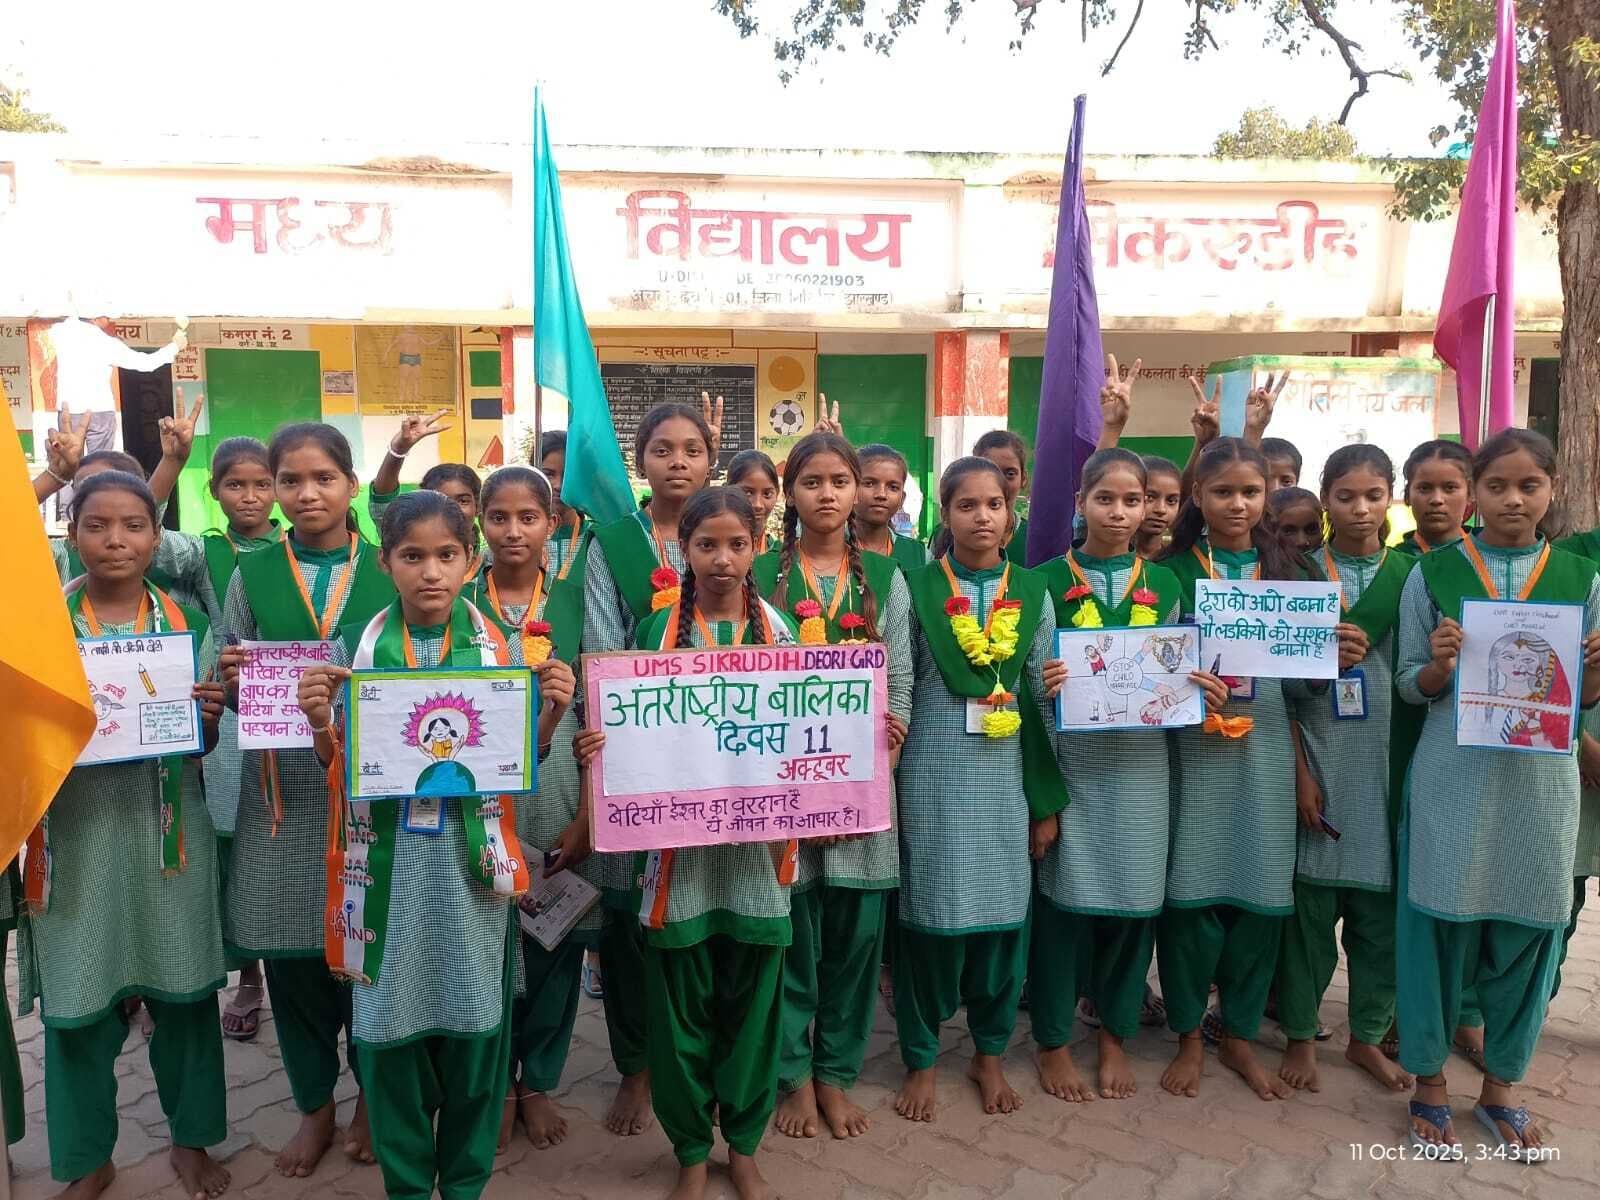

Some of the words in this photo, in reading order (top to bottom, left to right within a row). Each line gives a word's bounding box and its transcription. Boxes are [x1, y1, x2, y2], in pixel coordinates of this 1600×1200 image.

[195, 195, 399, 256] मध्य
[615, 189, 911, 269] विद्यालय
[1043, 197, 1357, 279] िकरुडीह
[282, 328, 293, 341] 2
[1228, 586, 1250, 612] को
[634, 656, 682, 677] UMS
[804, 650, 846, 671] DEORI
[768, 674, 873, 718] बालिका
[714, 719, 790, 757] दिवस
[803, 724, 832, 755] 11
[776, 754, 852, 782] अक्टूबर
[607, 799, 668, 828] बेटियाँ
[709, 799, 728, 816] का
[731, 793, 787, 816] वरदान
[725, 814, 769, 832] जीवन
[773, 815, 794, 830] का
[482, 856, 519, 878] HIND
[338, 872, 375, 889] HIND
[335, 922, 376, 944] HIND
